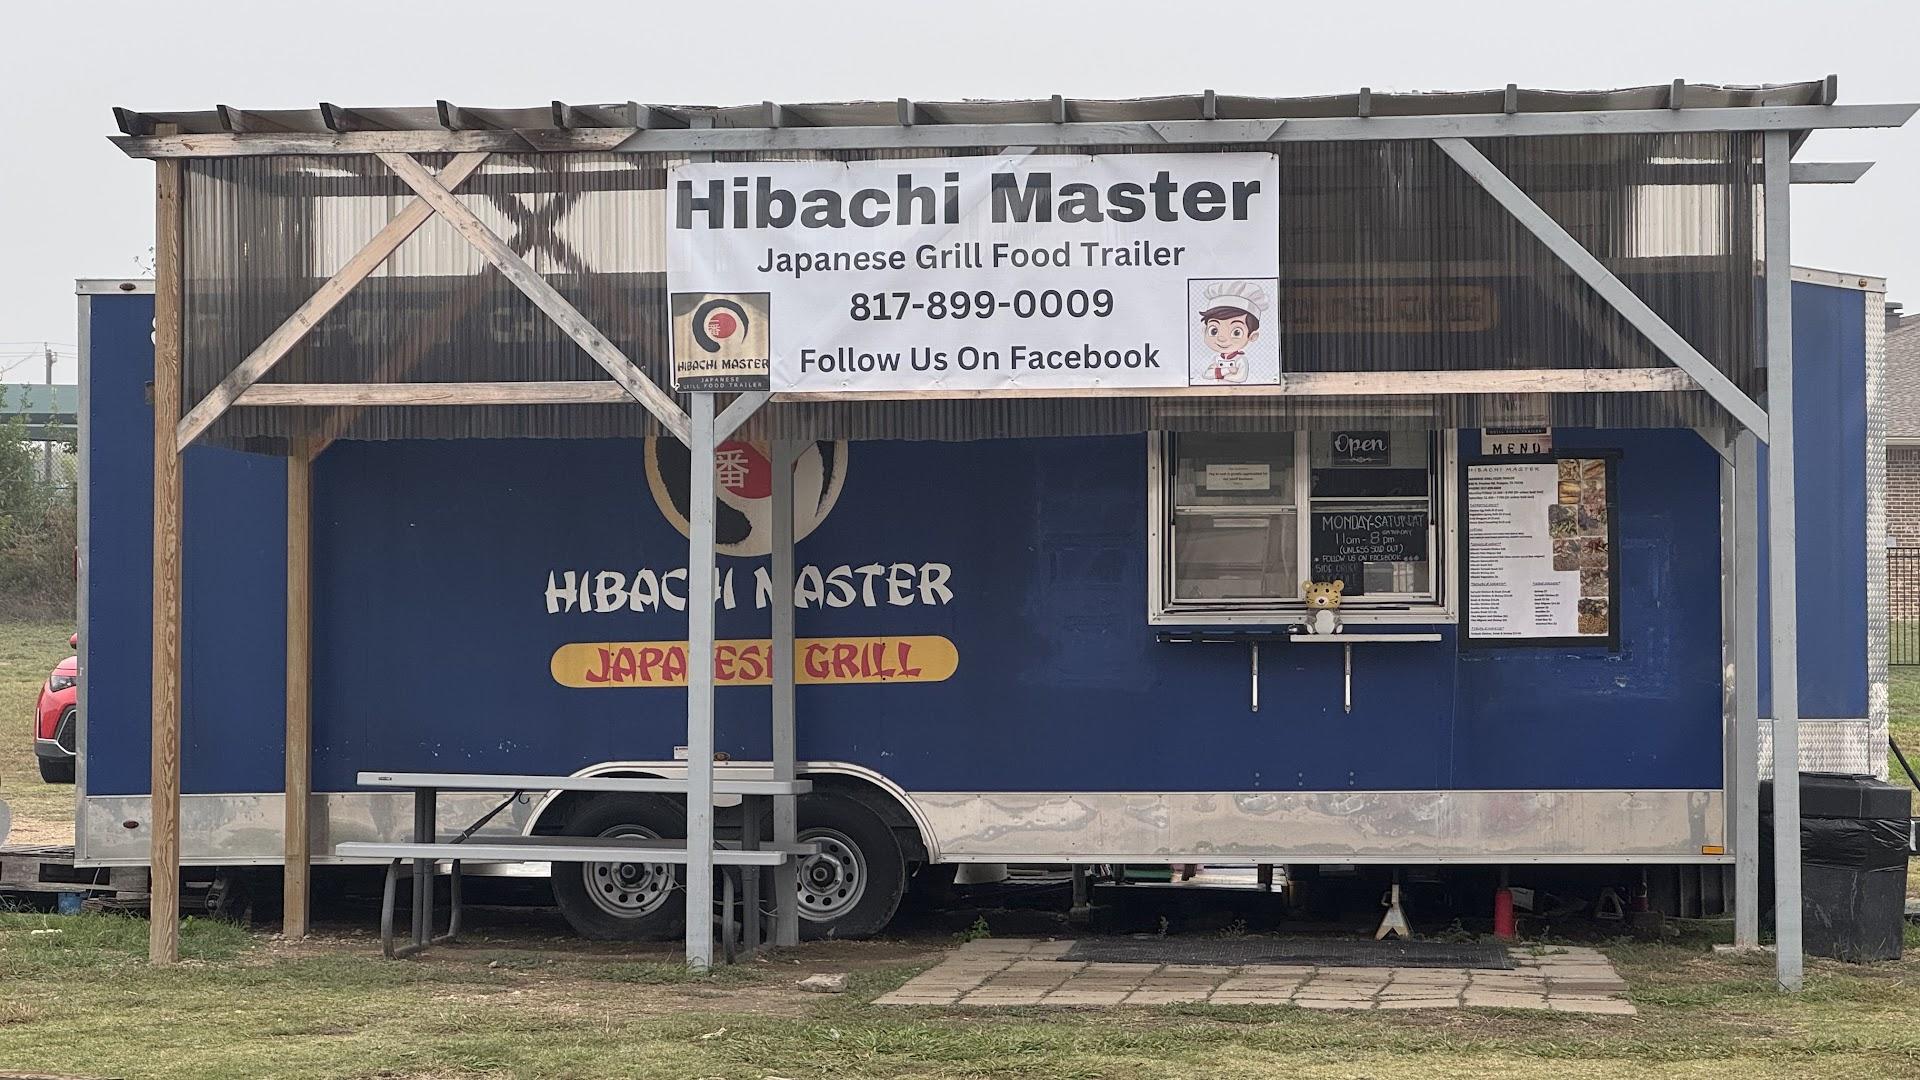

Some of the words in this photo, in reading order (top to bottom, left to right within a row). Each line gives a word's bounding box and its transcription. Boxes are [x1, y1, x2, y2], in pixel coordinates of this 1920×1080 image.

[677, 172, 959, 229] Hibachi
[992, 171, 1260, 223] Master
[757, 248, 905, 279] Japanese
[915, 243, 982, 269] Grill
[993, 242, 1070, 268] Food
[1080, 241, 1186, 267] Trailer
[850, 289, 1114, 321] 817-899-0009
[677, 359, 718, 372] HIBACHI
[721, 358, 769, 370] MASTER
[801, 347, 901, 372] Follow
[911, 347, 948, 372] Us
[958, 346, 999, 370] On
[1011, 343, 1161, 370] Facebook
[1335, 434, 1387, 457] Open
[1492, 442, 1541, 454] MENU
[1336, 532, 1360, 545] 11am
[1370, 531, 1380, 545] 8
[1383, 536, 1395, 545] pm
[1339, 545, 1370, 554] (UNLESS
[1370, 545, 1385, 553] SOLD
[545, 567, 736, 613] HIBACI
[586, 644, 772, 682] JAPAES
[805, 642, 922, 679] GRILL
